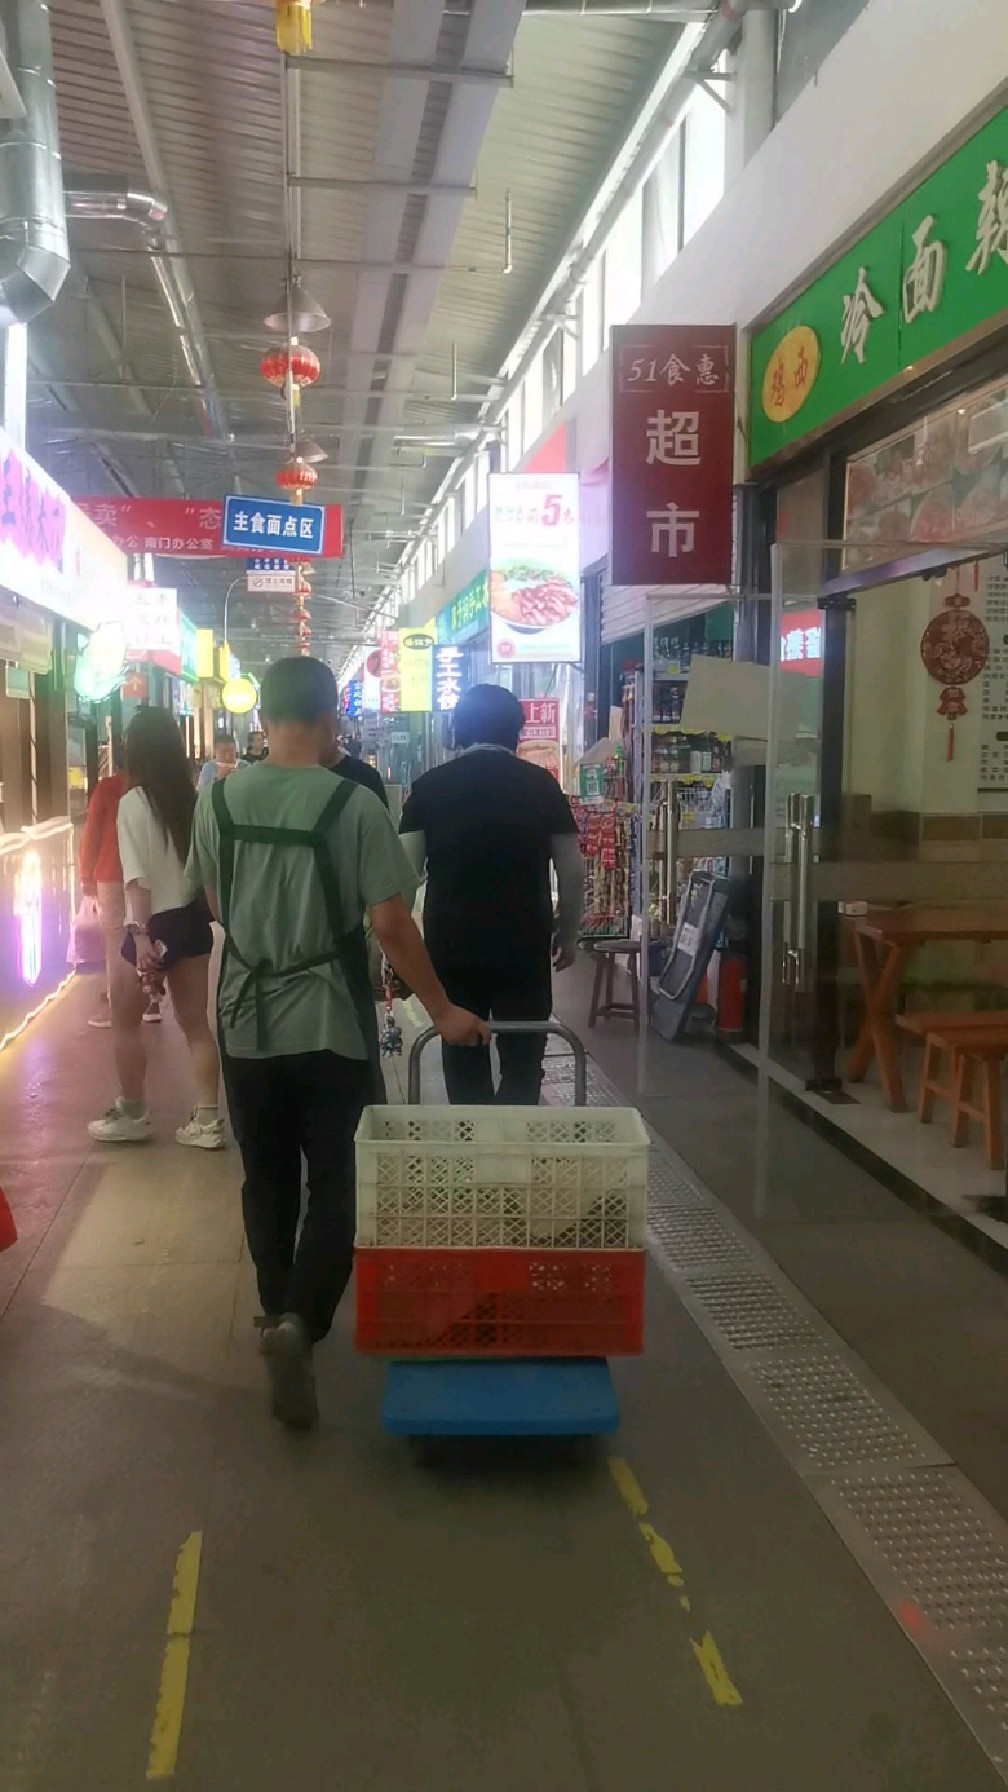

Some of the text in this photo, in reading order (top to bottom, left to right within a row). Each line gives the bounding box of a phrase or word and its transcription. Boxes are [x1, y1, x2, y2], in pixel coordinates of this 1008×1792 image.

[645, 409, 701, 558] 超市
[233, 511, 314, 539] 主食面点区
[525, 702, 556, 724] 上新
